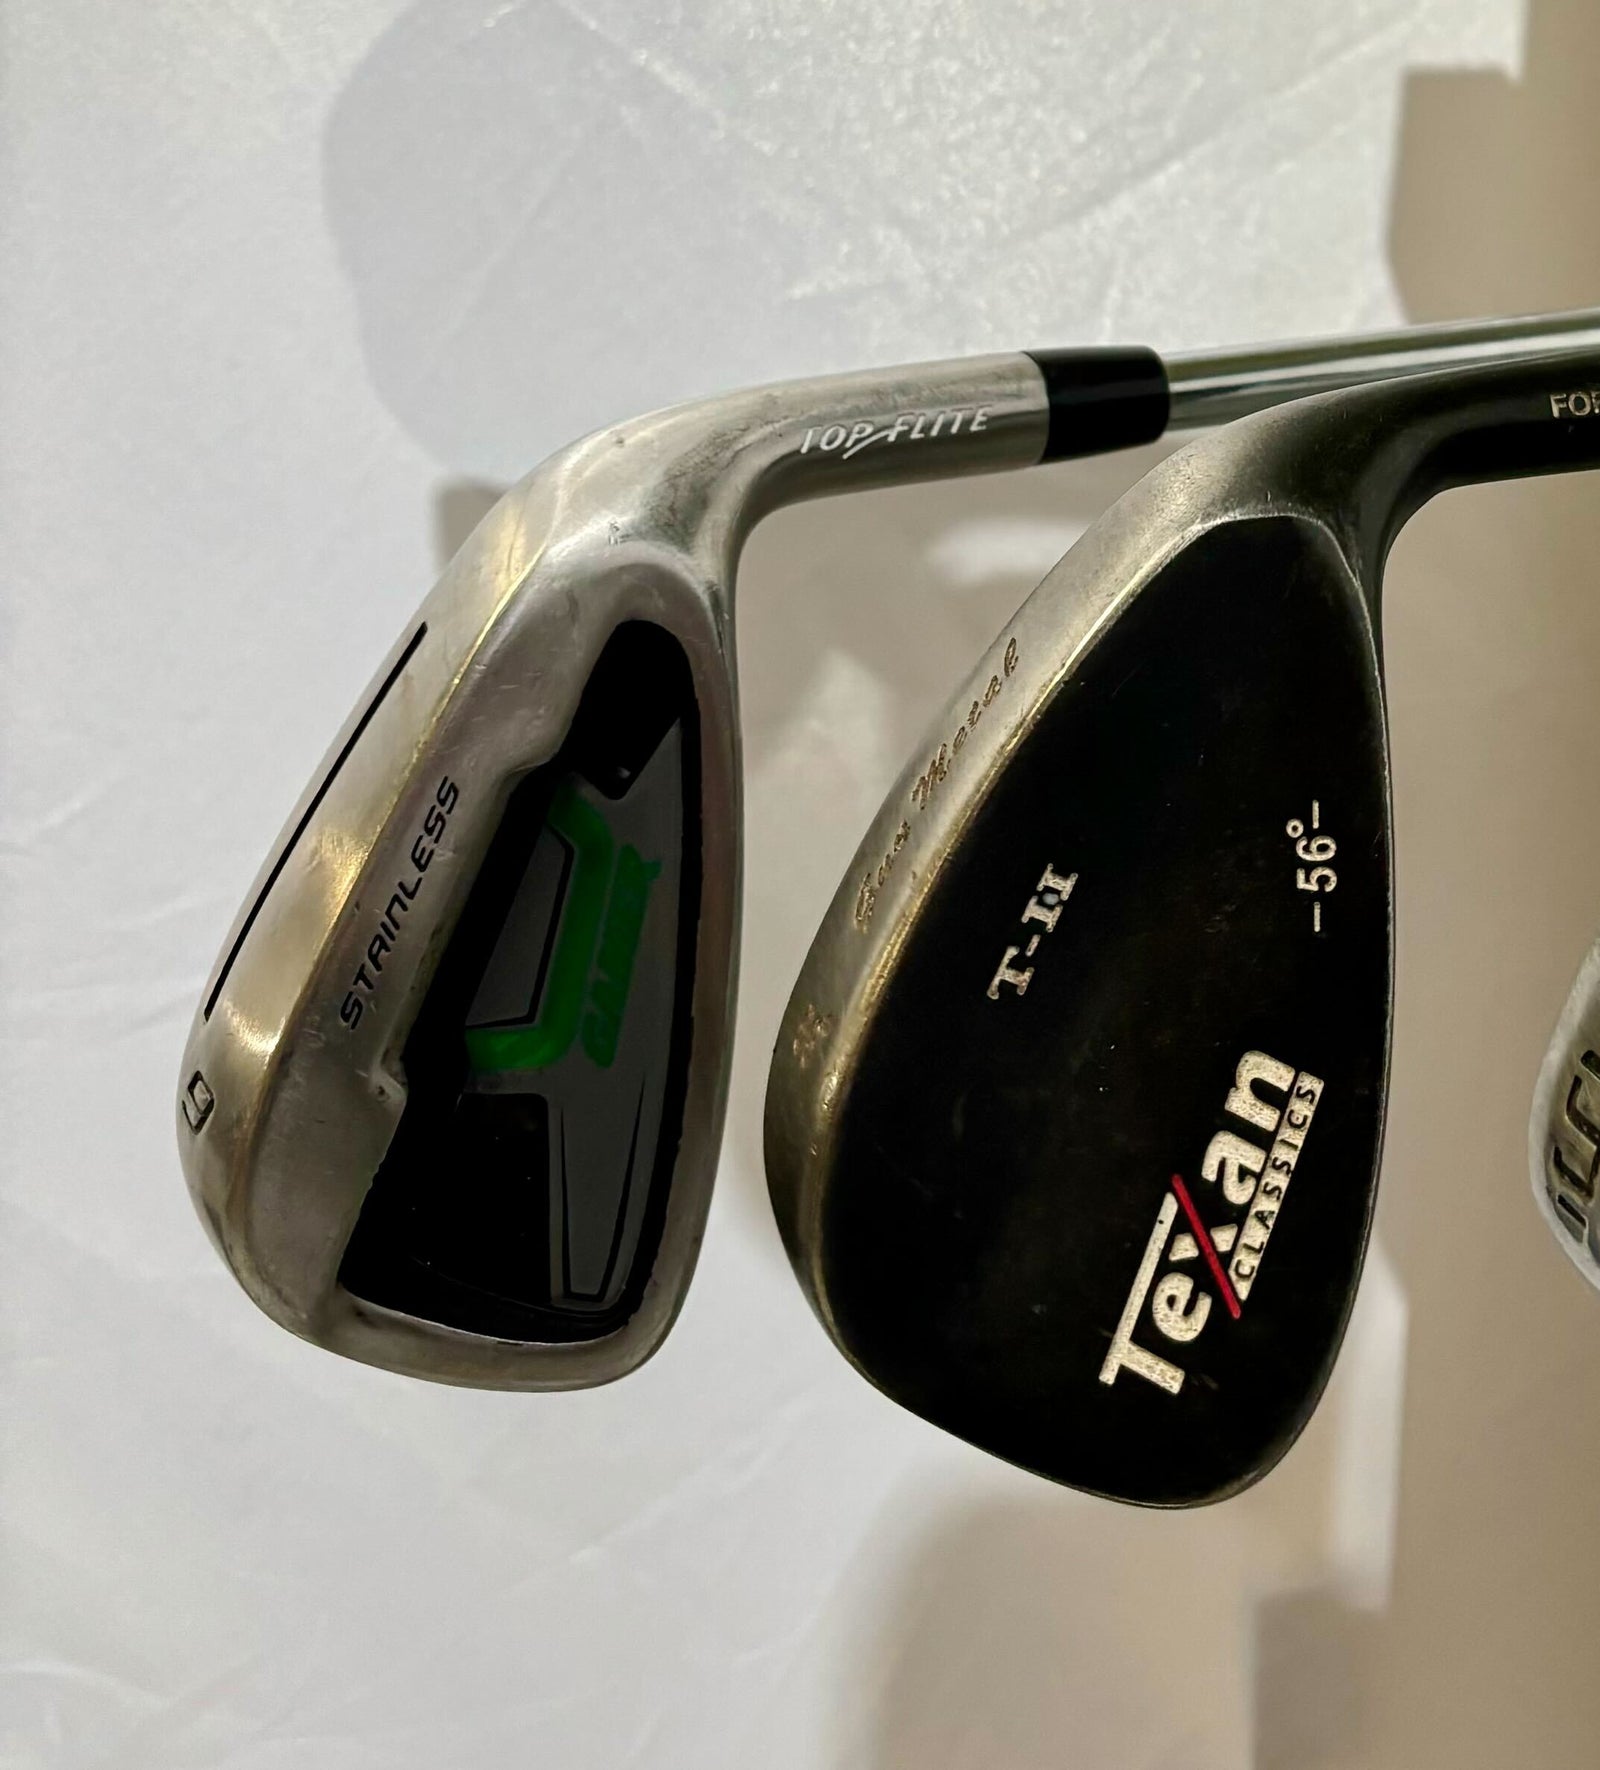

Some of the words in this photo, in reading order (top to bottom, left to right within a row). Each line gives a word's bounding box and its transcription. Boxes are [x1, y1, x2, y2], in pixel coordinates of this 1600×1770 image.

[800, 420, 876, 455] TOP
[862, 404, 993, 450] FLITE
[339, 775, 460, 1031] STAINLESS
[1098, 1050, 1297, 1395] Texan
[1233, 1083, 1317, 1281] CLASSICS
